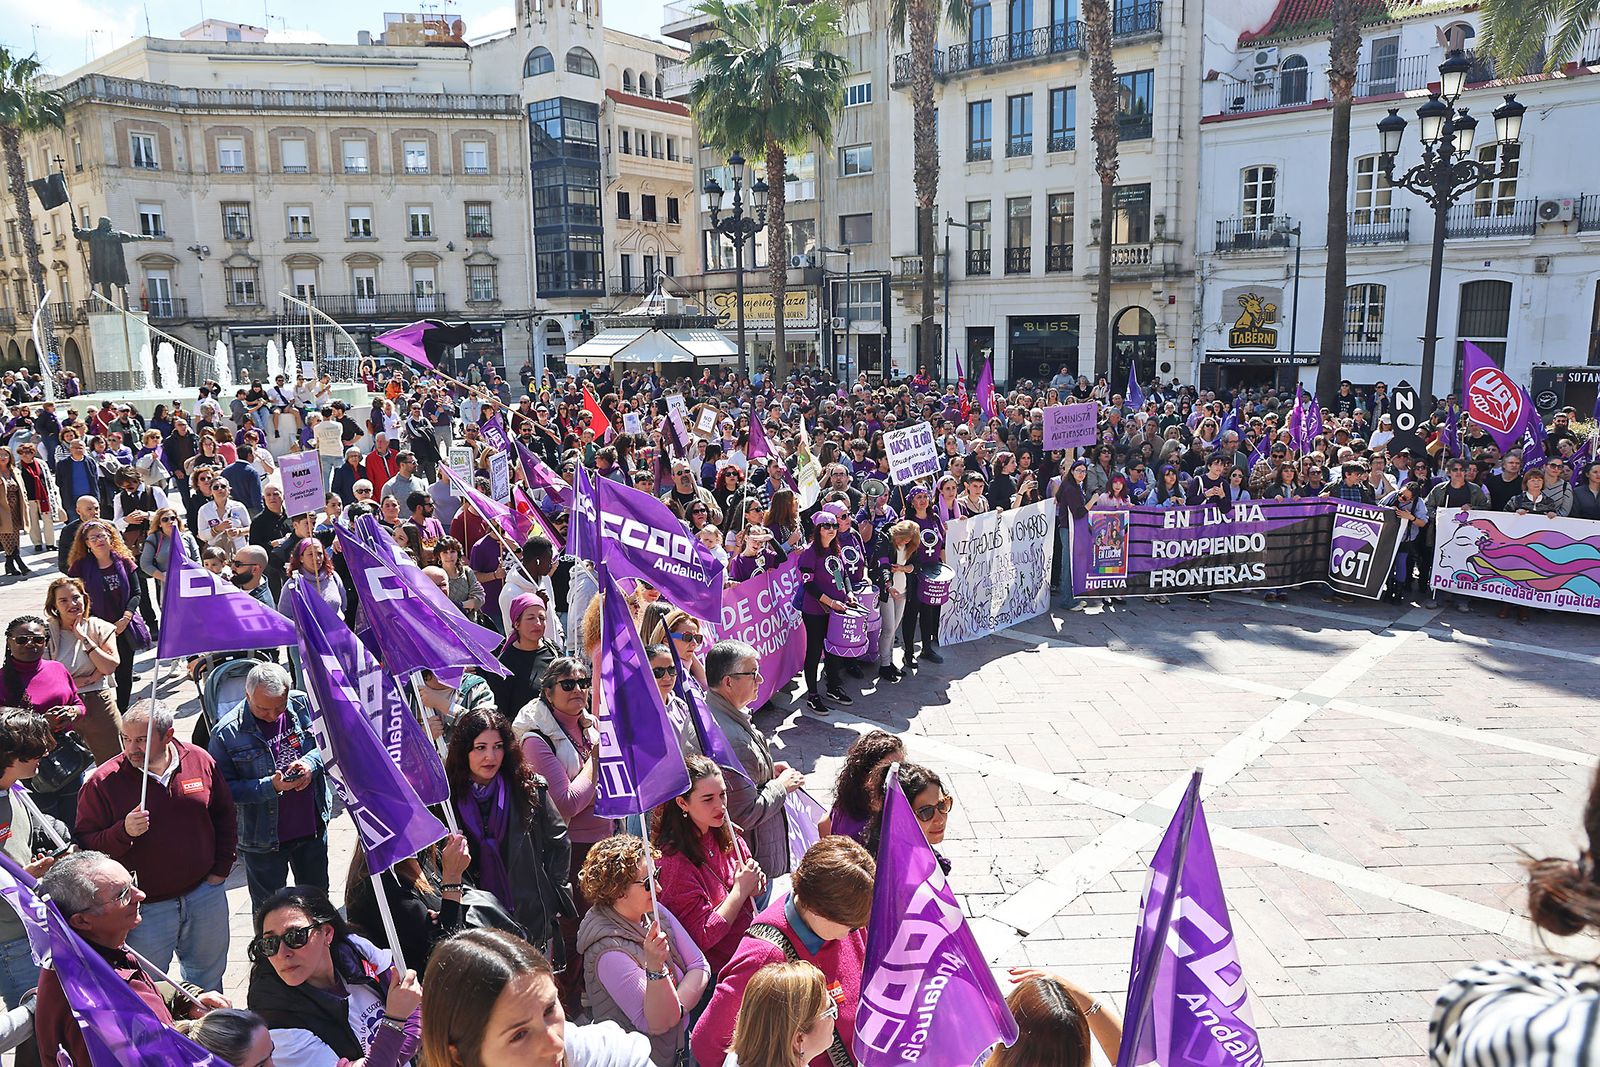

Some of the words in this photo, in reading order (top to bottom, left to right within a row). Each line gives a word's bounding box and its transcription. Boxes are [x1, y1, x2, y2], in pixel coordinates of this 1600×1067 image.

[1024, 322, 1069, 331] BLISS
[1475, 371, 1518, 419] UGT
[292, 468, 311, 478] MATA
[1164, 511, 1190, 528] EN
[1336, 504, 1385, 521] HUELVA
[1152, 533, 1266, 558] ROMPIENDO
[1150, 563, 1266, 588] FRONTERAS
[1331, 547, 1370, 580] CGT
[1085, 580, 1127, 590] HUELVA
[1433, 574, 1453, 589] Por
[1456, 581, 1478, 591] una
[1481, 582, 1536, 601] sociedad
[1536, 591, 1551, 603] en
[721, 598, 752, 631] DE
